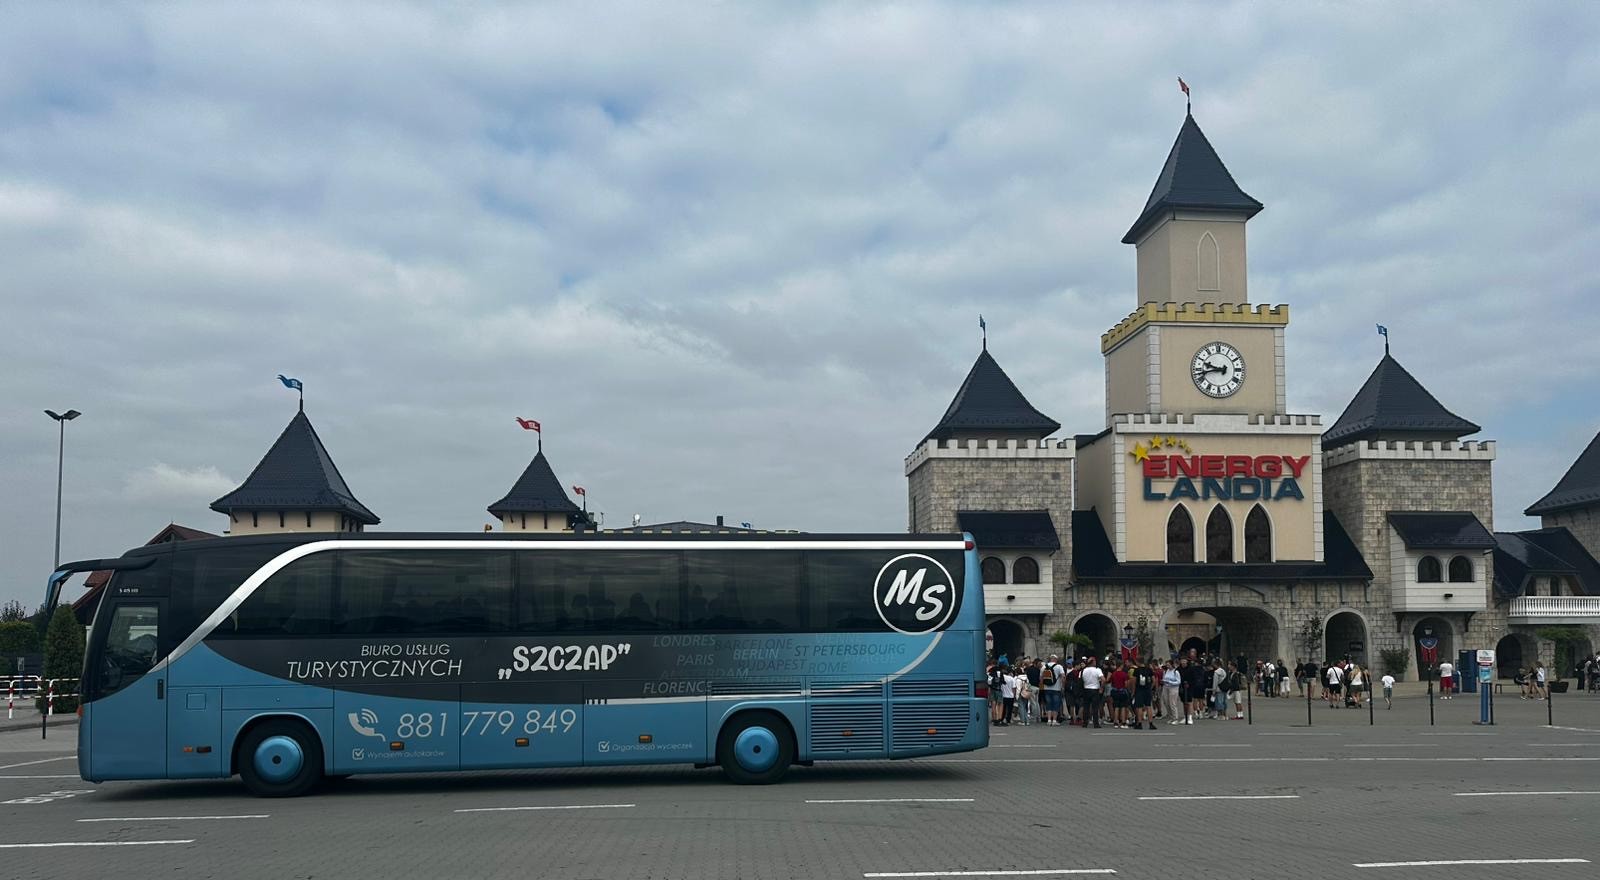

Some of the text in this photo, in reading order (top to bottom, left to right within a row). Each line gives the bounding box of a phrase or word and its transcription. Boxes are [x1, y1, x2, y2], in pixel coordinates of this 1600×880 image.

[1142, 455, 1311, 478] ENERGY
[1142, 476, 1304, 501] LANDIA
[883, 567, 947, 621] MS
[653, 635, 717, 648] LONDRES
[361, 643, 450, 656] BIURO USŁUG
[732, 648, 780, 661] BERLIN
[794, 643, 906, 658] ST PETERSBOURG
[676, 654, 715, 667] PARIS
[808, 661, 849, 674] ROME
[287, 659, 463, 678] TURYSTYCZNYCH
[642, 681, 714, 694] FLORENCE
[397, 708, 577, 739] 881 779 849
